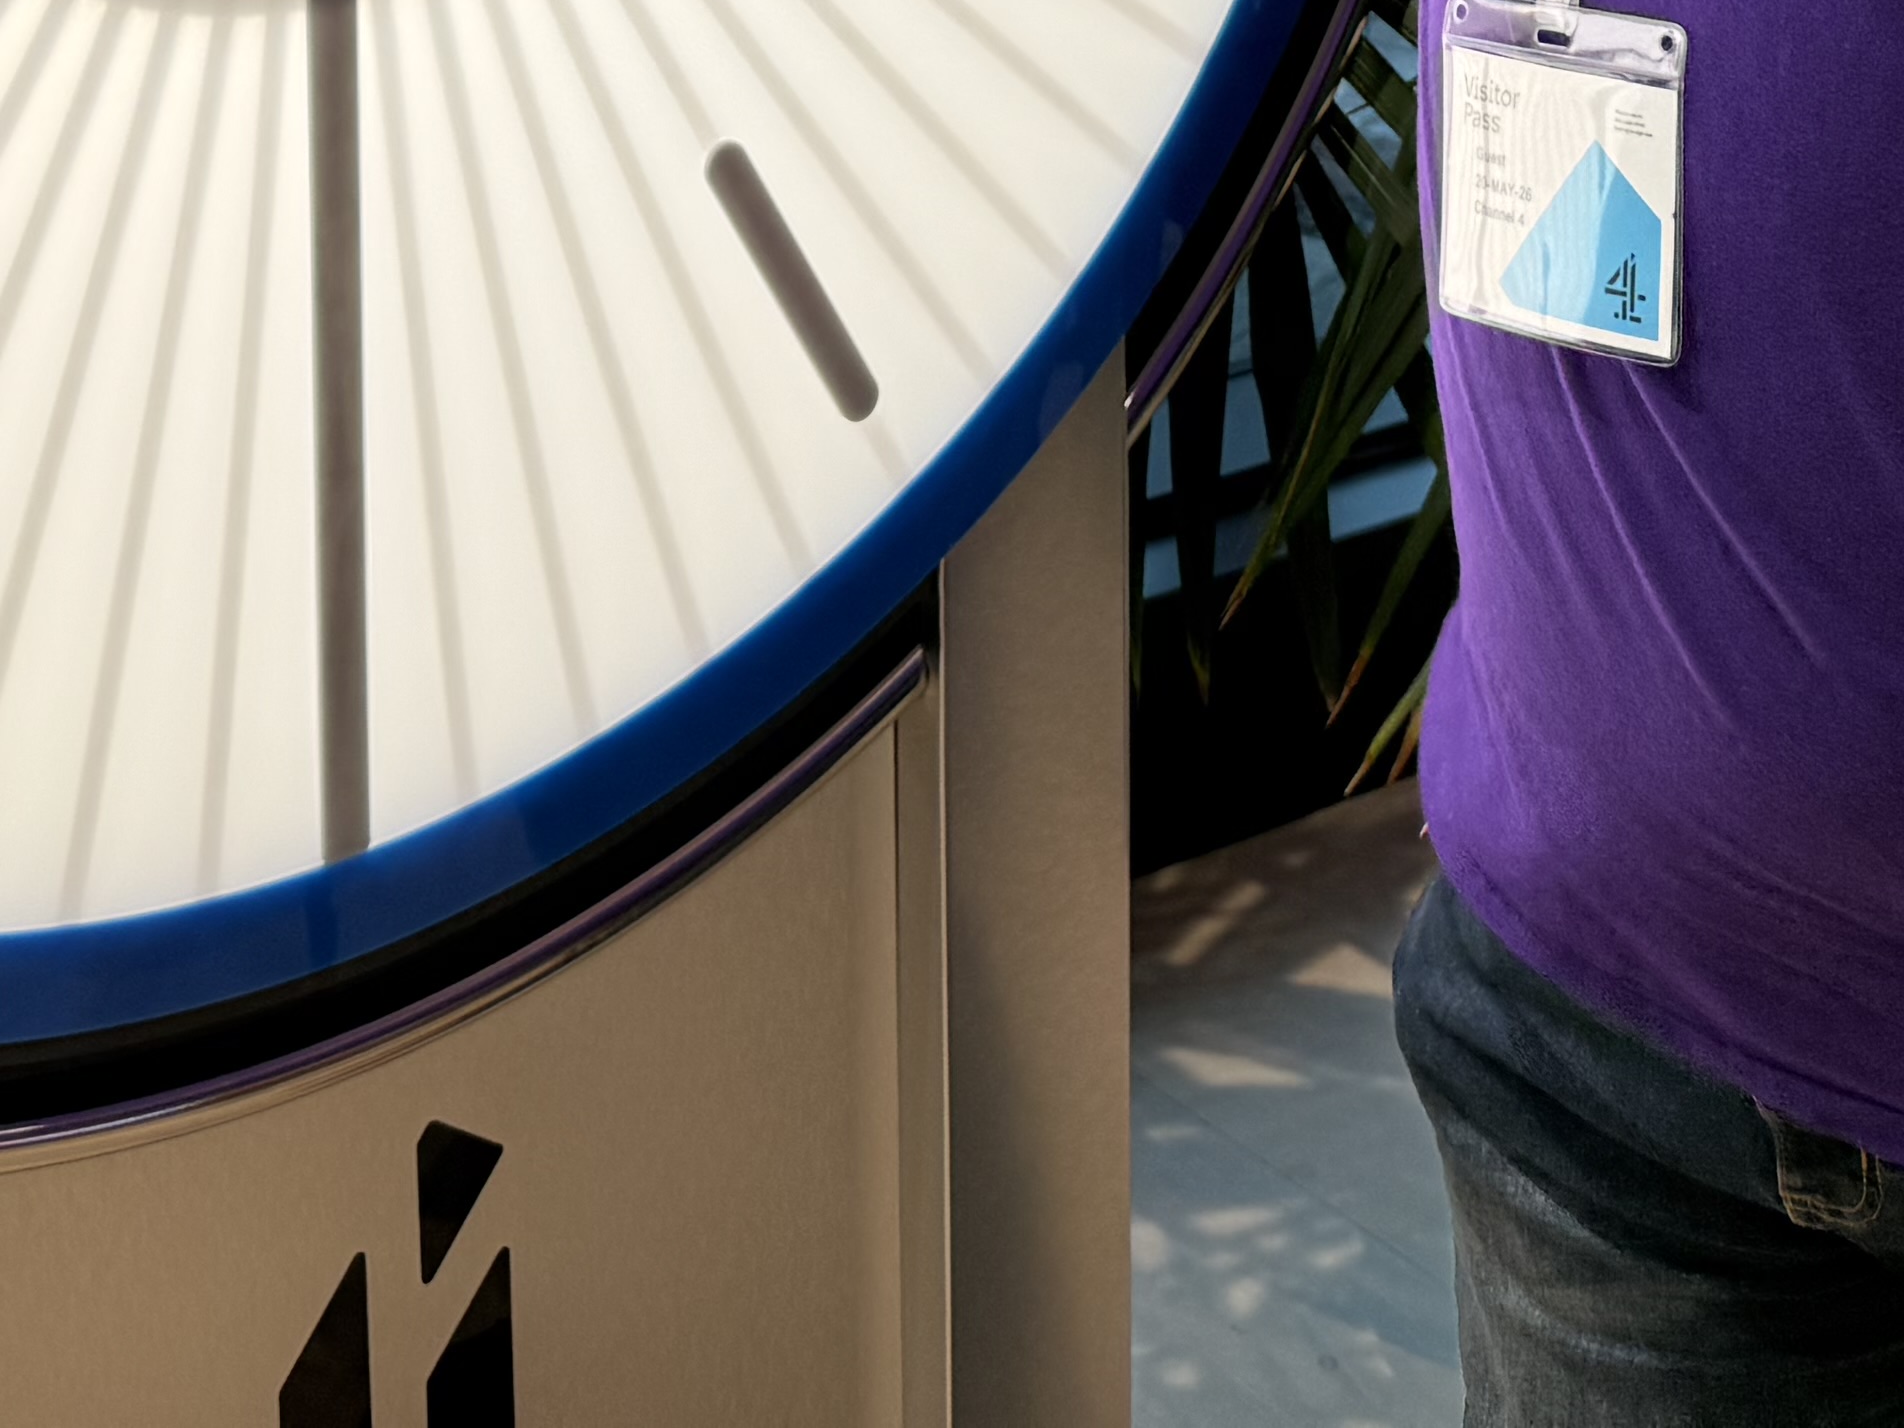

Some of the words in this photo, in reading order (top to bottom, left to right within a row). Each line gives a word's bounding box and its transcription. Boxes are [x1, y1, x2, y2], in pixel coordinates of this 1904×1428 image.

[1464, 72, 1521, 109] Visitor
[1464, 101, 1502, 133] Pass
[1476, 146, 1506, 167] Guest
[1474, 199, 1516, 225] Channel
